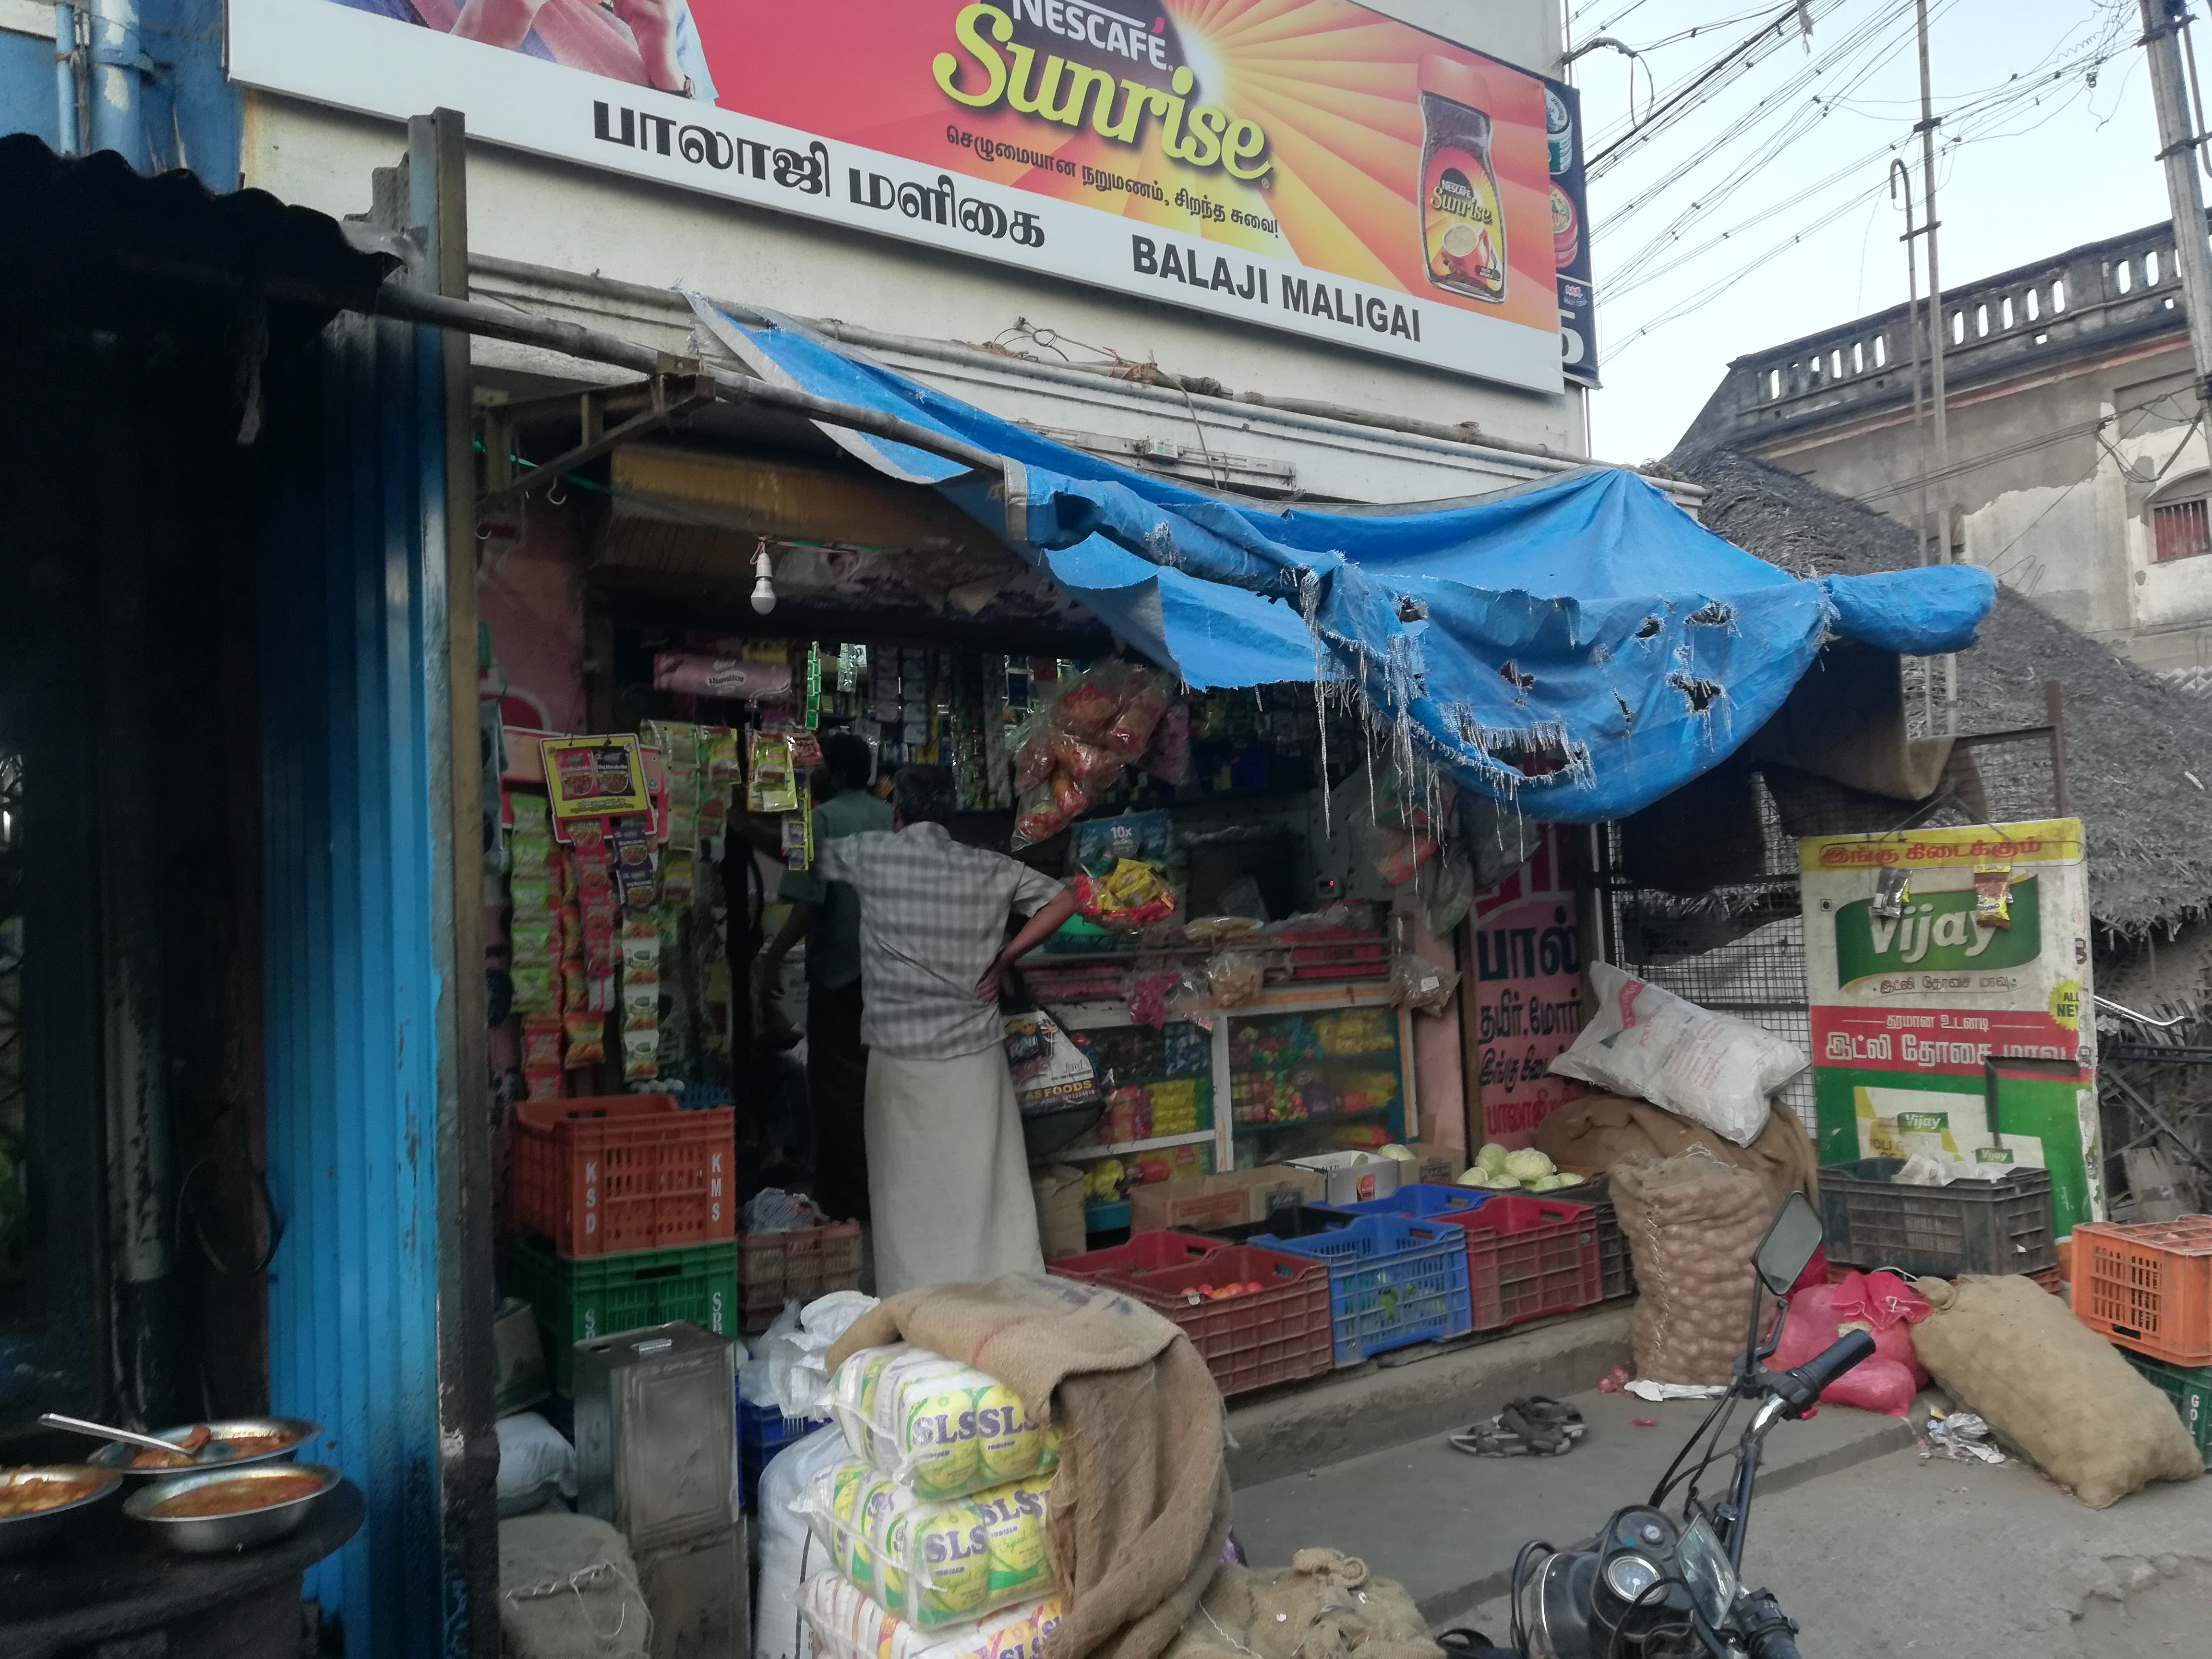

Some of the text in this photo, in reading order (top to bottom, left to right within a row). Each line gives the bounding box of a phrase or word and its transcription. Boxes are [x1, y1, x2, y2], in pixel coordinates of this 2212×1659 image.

[932, 3, 1274, 180] Sunrise
[593, 100, 1045, 248] பாலாஜி மளிகை
[947, 125, 1076, 177] செழுமையான
[1174, 190, 1226, 223] சிறந்த
[1230, 210, 1278, 239] சுவை!
[1430, 187, 1491, 222] Sunrise
[1131, 235, 1421, 342] BALAJI MALIGAI
[1822, 836, 2042, 865] இங்கு கிடைக்கும்
[1477, 905, 1581, 981] பால்
[1868, 903, 2004, 963] Vijay
[1880, 977, 1915, 994] இட்லி
[1922, 976, 1972, 990] தோசை
[1887, 1014, 1989, 1032] தரமான உடனடி
[1826, 1032, 1893, 1060] இட்லி
[1901, 1034, 1993, 1067] தோசை
[1044, 1080, 1093, 1097] FOODS
[1905, 1114, 1941, 1130] Vijay
[1981, 1149, 2008, 1162] Vijay
[711, 1153, 722, 1221] KMS
[913, 1410, 976, 1446] SLS
[926, 1525, 987, 1563] SLS
